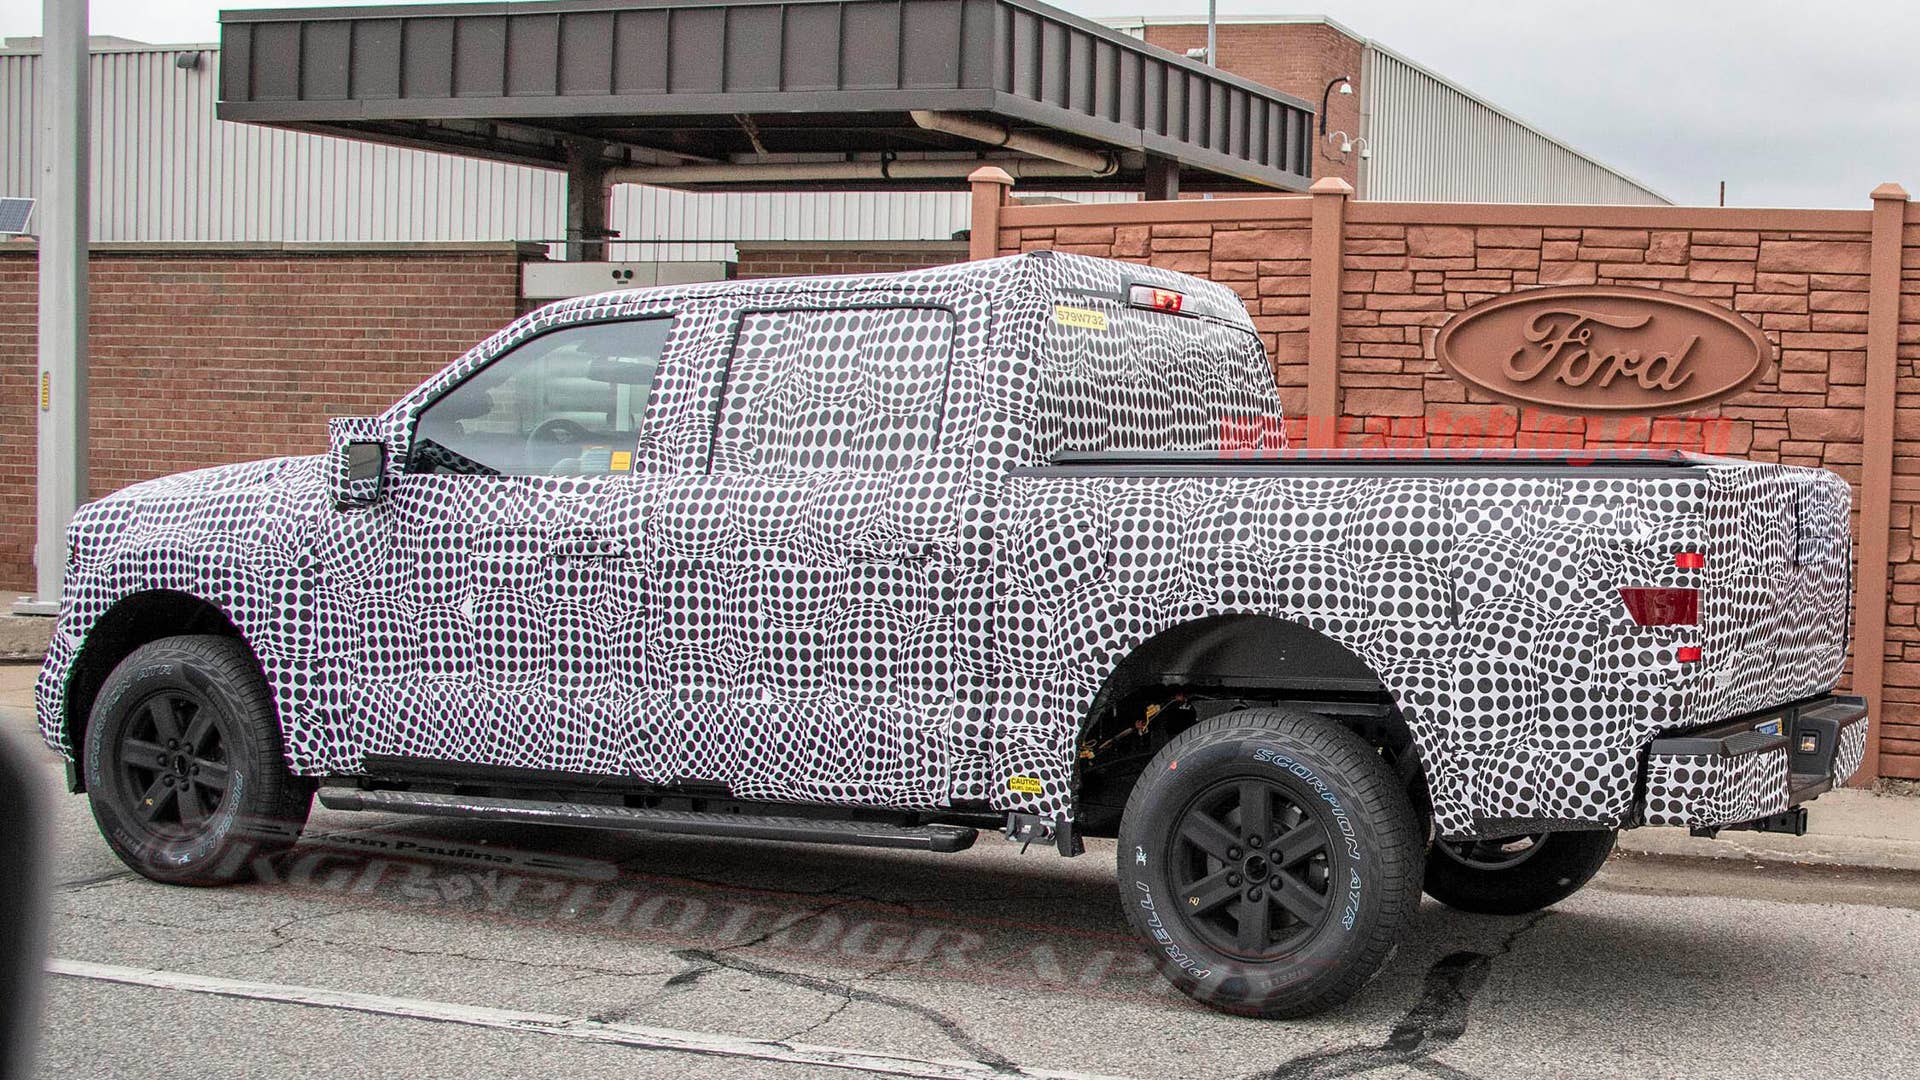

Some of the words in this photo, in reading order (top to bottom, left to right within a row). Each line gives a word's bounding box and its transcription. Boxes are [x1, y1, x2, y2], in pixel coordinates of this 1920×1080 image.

[1502, 307, 1700, 391] Ford
[199, 769, 244, 858] PIRELLI
[1011, 777, 1041, 786] CAUTION
[1253, 748, 1361, 860] SCORPION
[1341, 867, 1362, 931] ATR
[1135, 880, 1212, 980] PIRELLI
